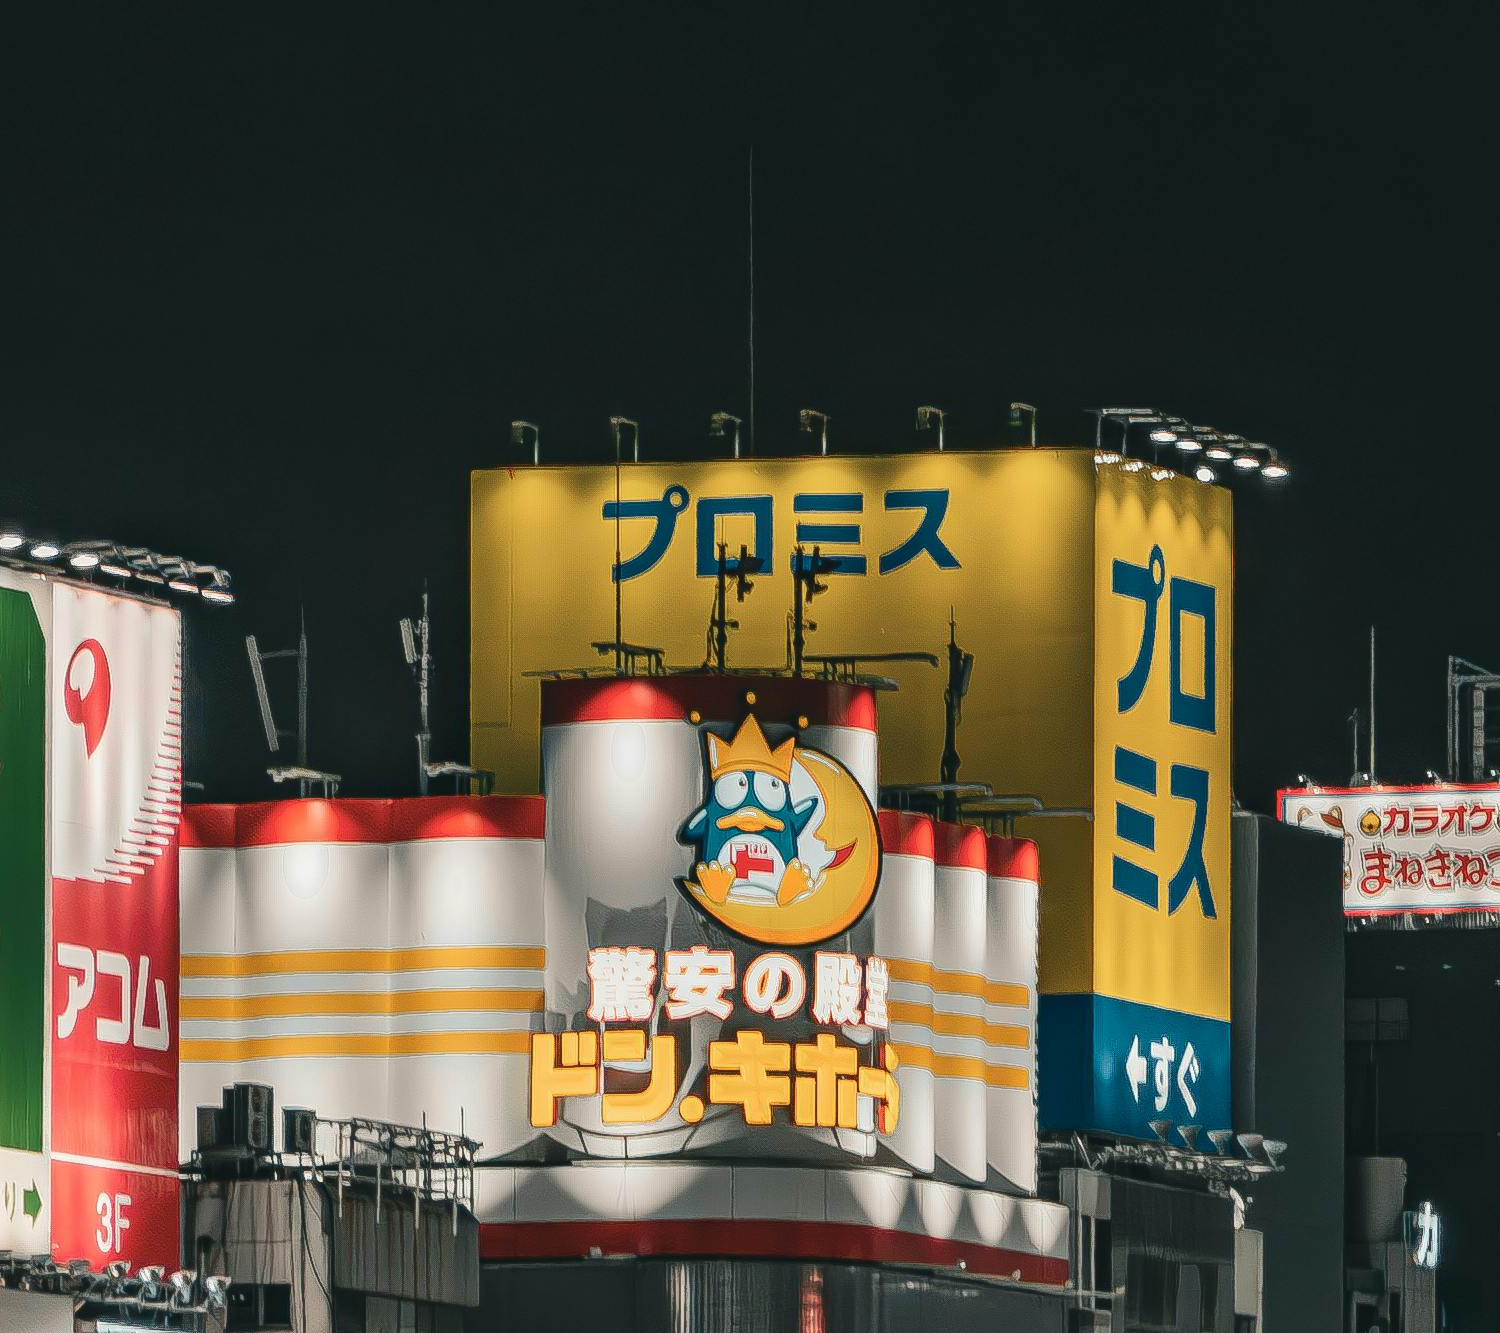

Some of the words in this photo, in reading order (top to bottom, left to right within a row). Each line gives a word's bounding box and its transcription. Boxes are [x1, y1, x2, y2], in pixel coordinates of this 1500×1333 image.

[602, 482, 962, 585] プロミス
[1382, 804, 1496, 834] カラオケ
[56, 944, 171, 1054] アコム
[1147, 1034, 1199, 1120] すぐ
[96, 1192, 132, 1256] 3F
